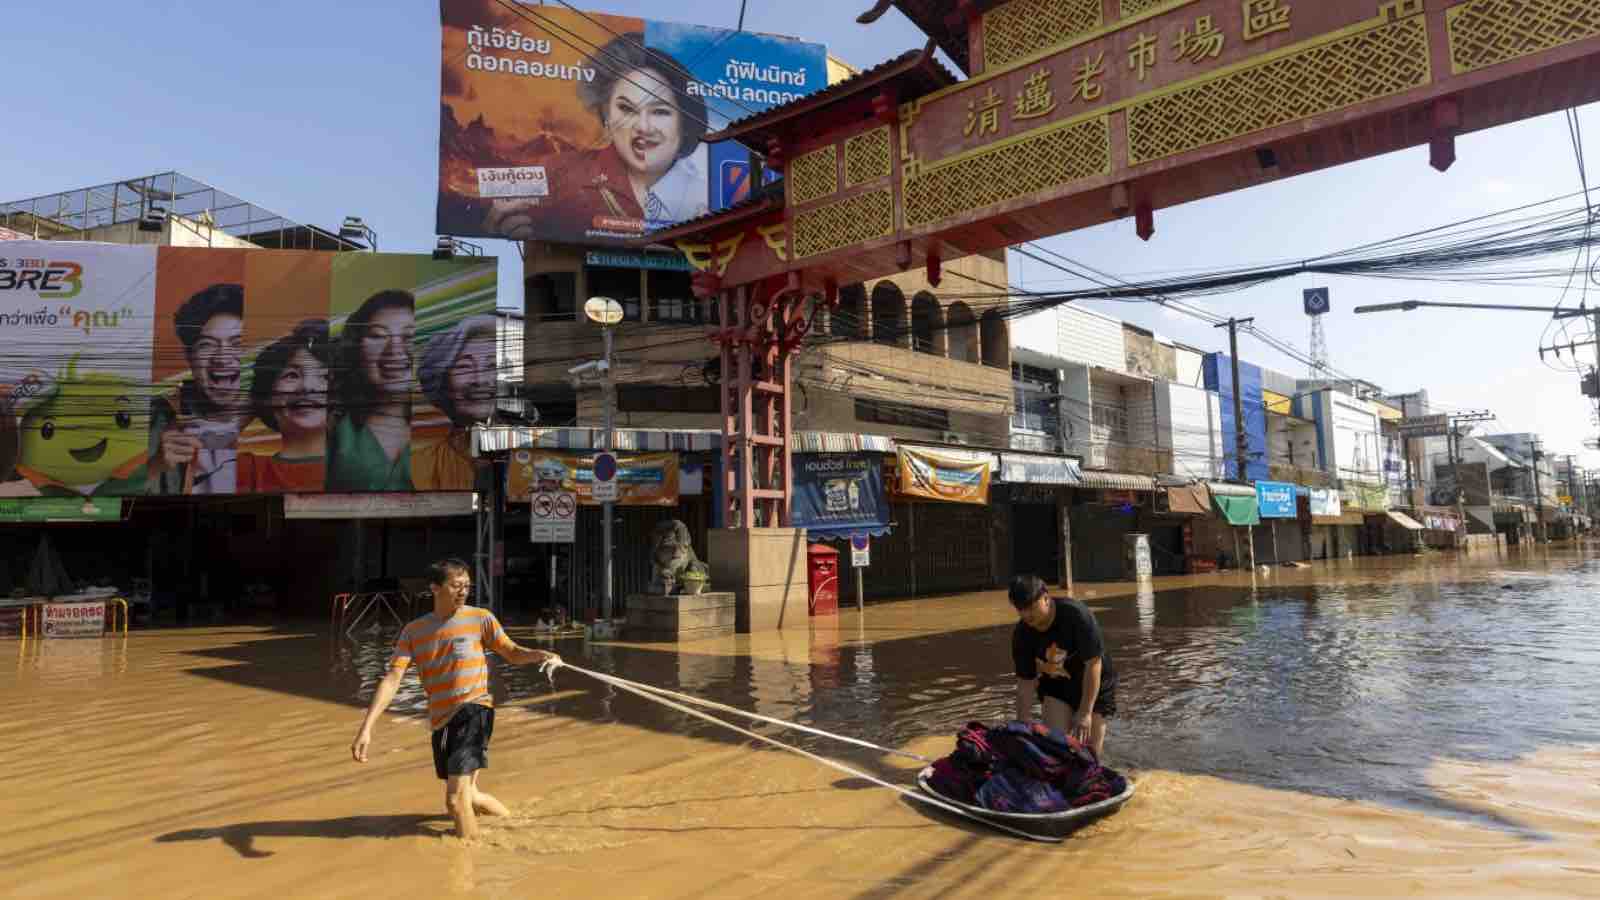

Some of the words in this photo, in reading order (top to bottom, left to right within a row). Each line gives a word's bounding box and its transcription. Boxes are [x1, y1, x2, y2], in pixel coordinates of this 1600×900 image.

[465, 53, 596, 82] ดอกลอยเก่ง
[963, 0, 1292, 137] 清邁老市場區
